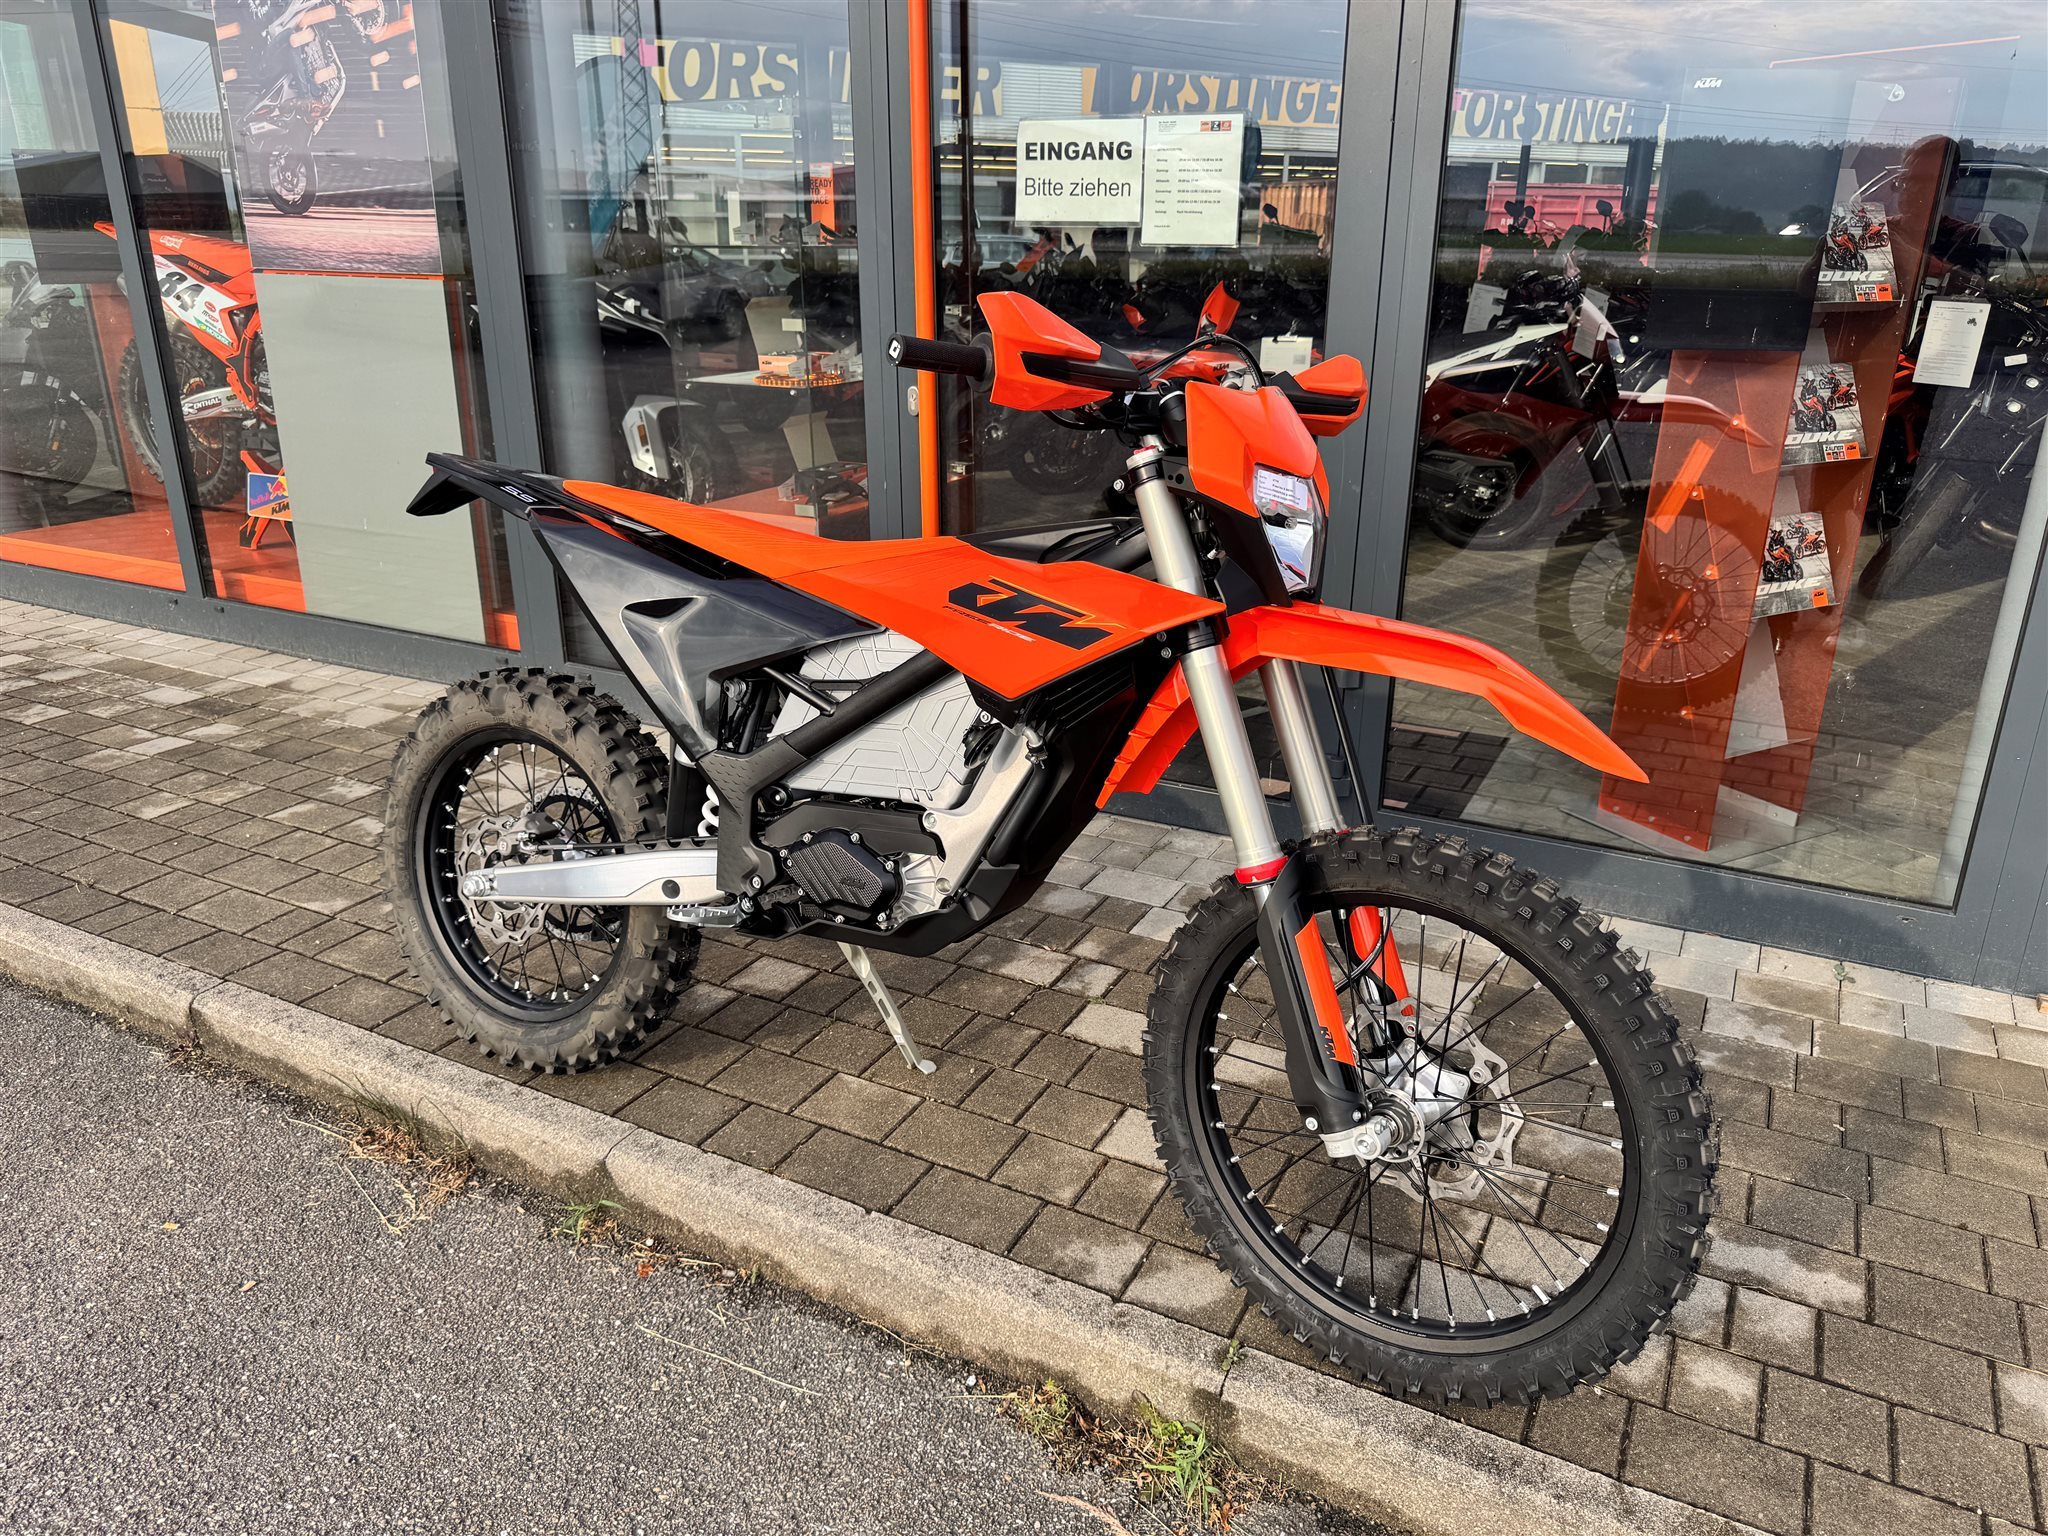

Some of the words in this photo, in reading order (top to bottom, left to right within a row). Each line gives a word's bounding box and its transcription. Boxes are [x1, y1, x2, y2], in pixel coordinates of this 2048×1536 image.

[1693, 77, 1722, 89] KTM
[1025, 141, 1133, 161] EINGANG
[810, 178, 832, 188] READY
[1024, 177, 1064, 196] Bitte
[1069, 177, 1131, 197] ziehen
[1817, 270, 1889, 282] DUKE
[158, 271, 206, 313] 84
[1784, 429, 1857, 446] DUKE
[1756, 575, 1826, 597] DUKE
[948, 578, 1114, 651] KTM
[1318, 1026, 1339, 1061] KTM
